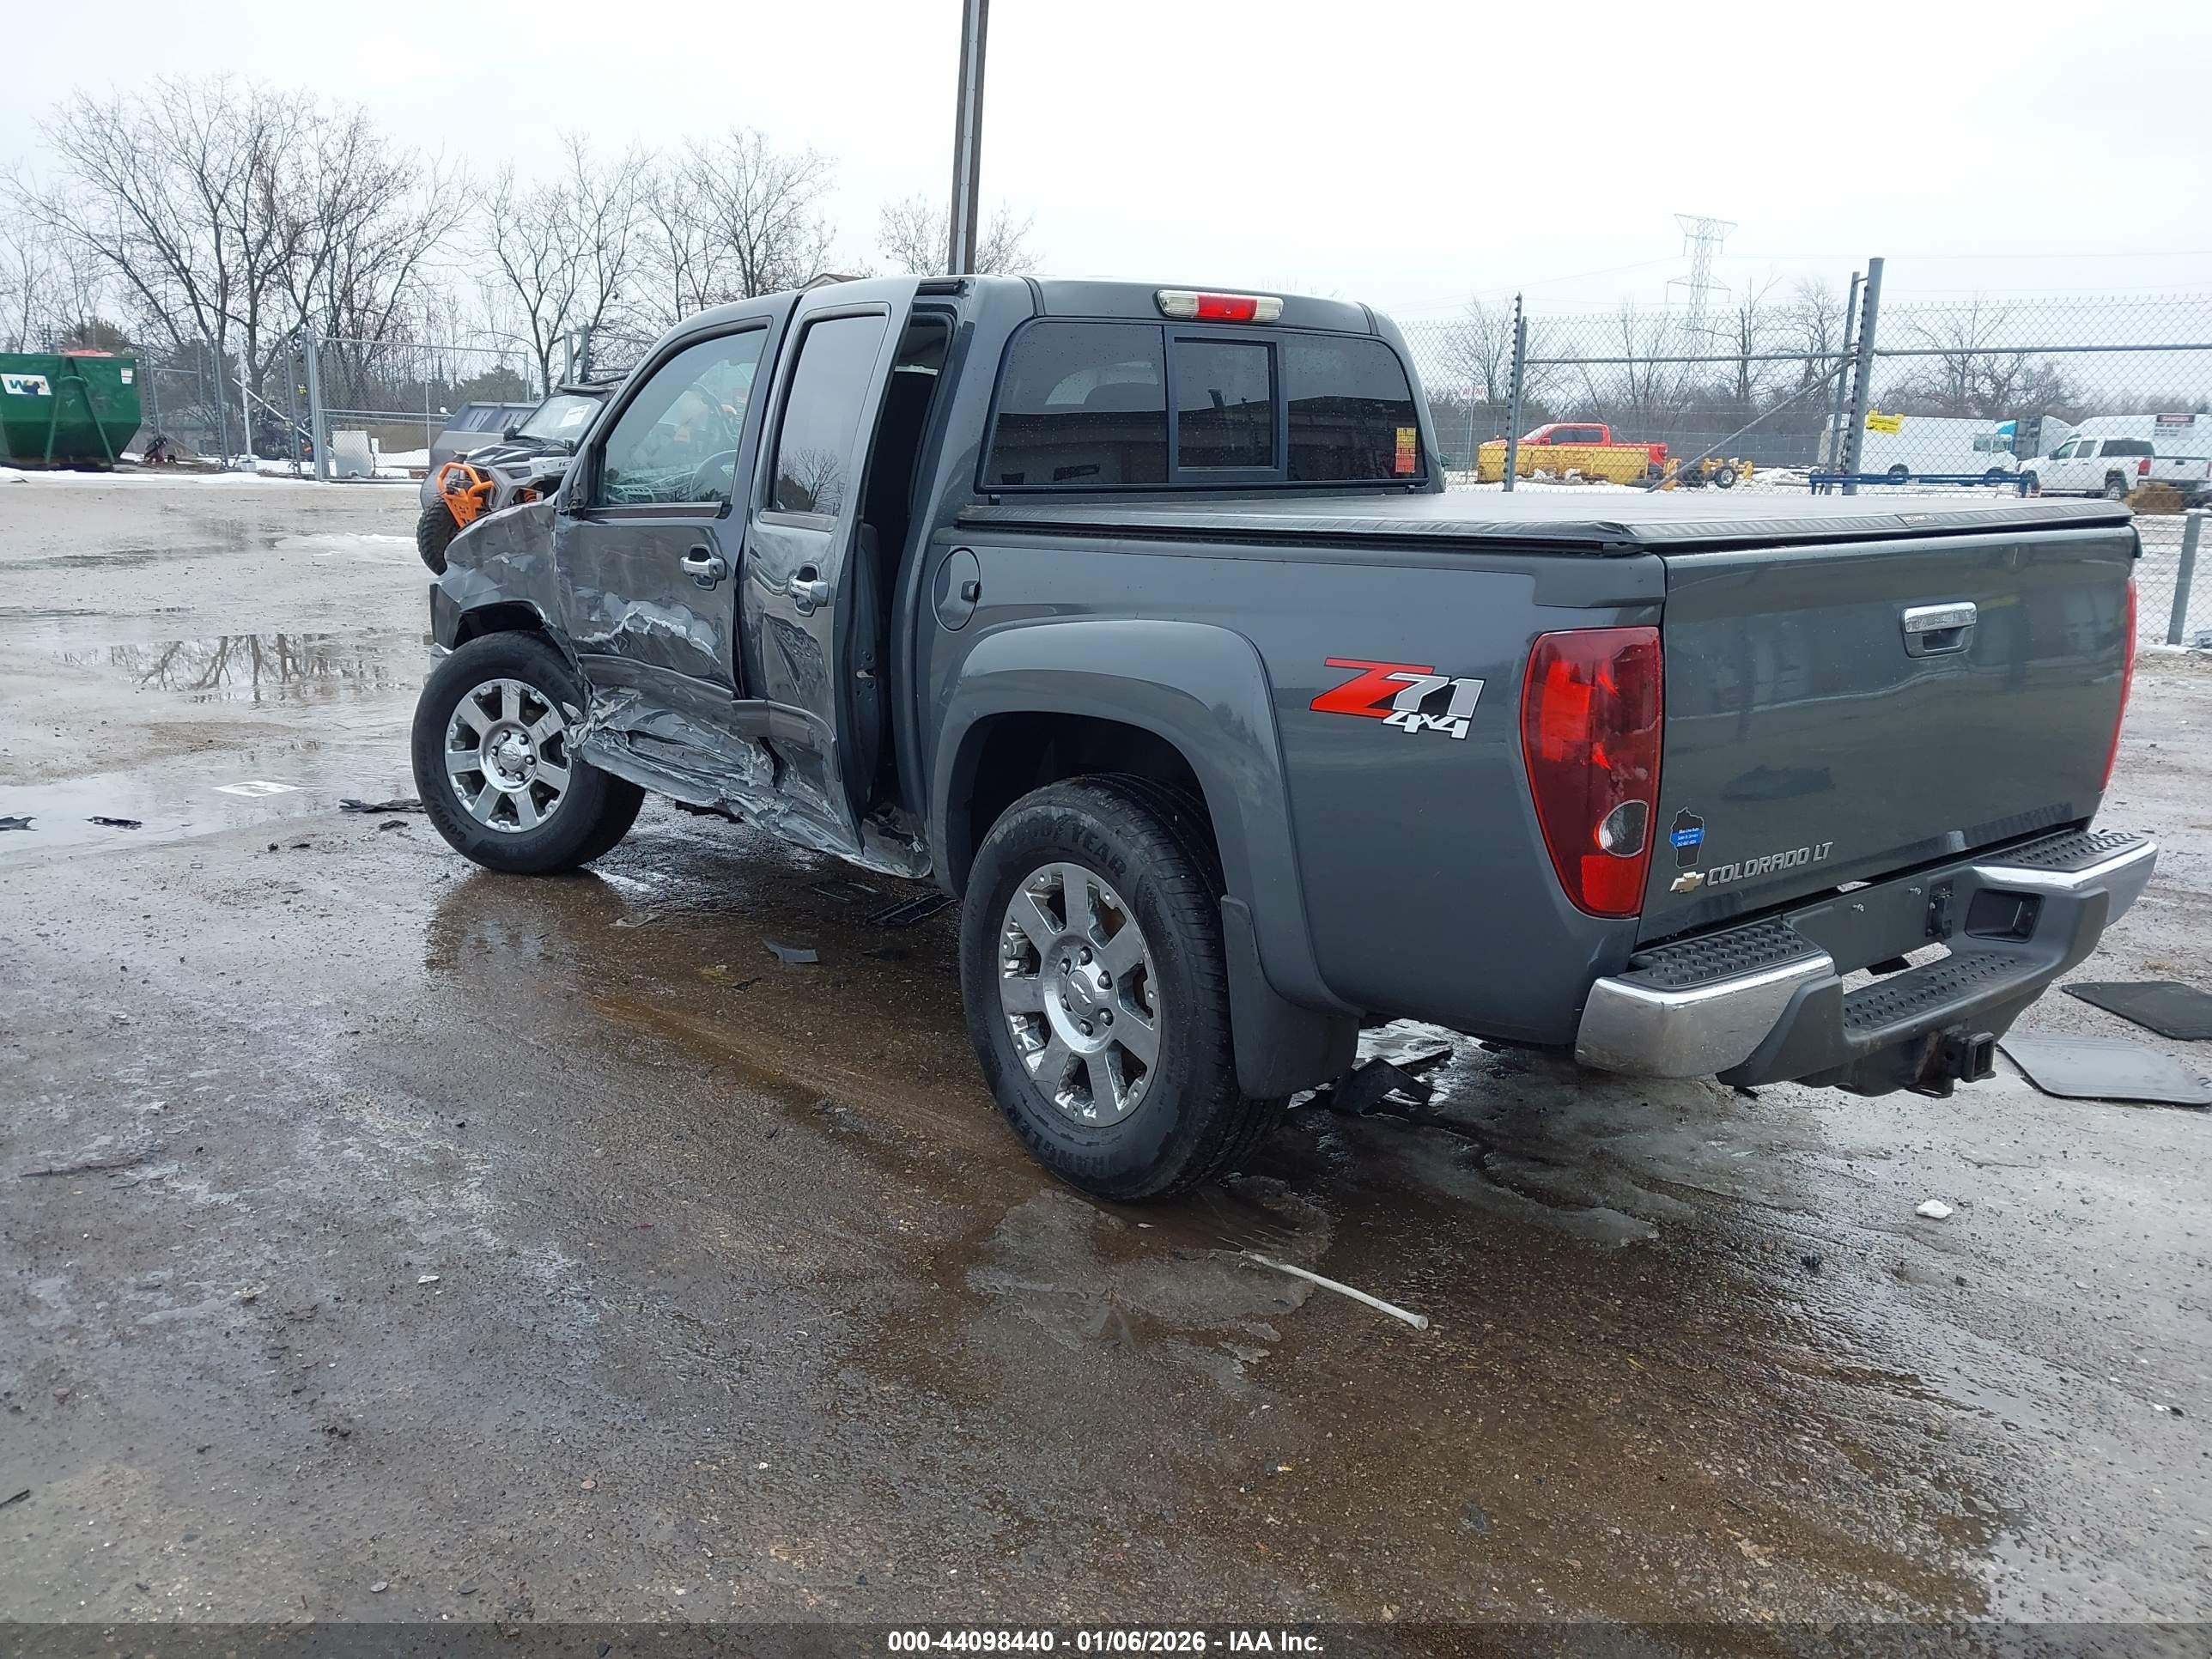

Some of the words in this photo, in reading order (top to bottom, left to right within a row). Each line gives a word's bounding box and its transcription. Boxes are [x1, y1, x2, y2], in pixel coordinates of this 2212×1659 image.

[1310, 657, 1487, 720] Z71
[1707, 847, 1809, 887] COLORADO
[1813, 842, 1834, 862] LT
